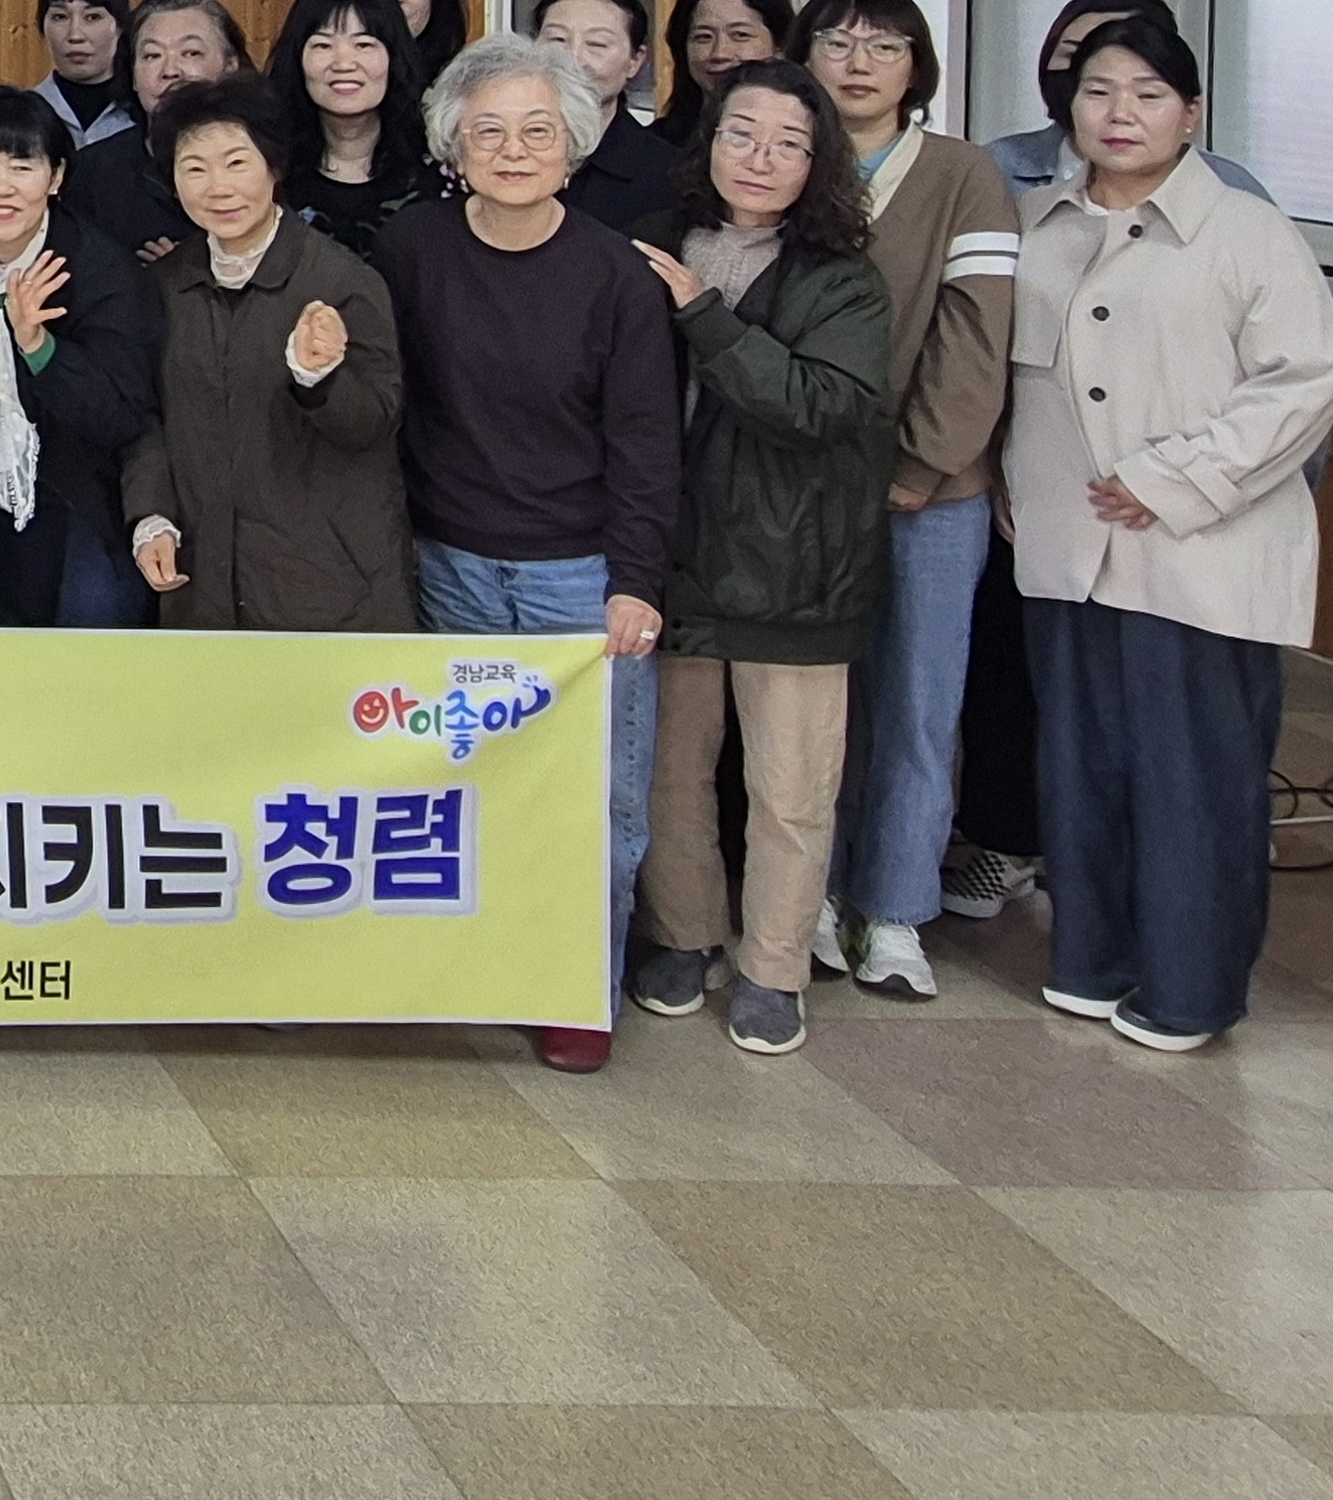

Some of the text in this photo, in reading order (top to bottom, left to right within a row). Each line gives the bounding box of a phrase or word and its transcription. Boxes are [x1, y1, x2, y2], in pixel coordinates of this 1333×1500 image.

[452, 664, 517, 683] 경남교육
[352, 675, 551, 760] 아이좋아
[264, 787, 466, 905] 청렴
